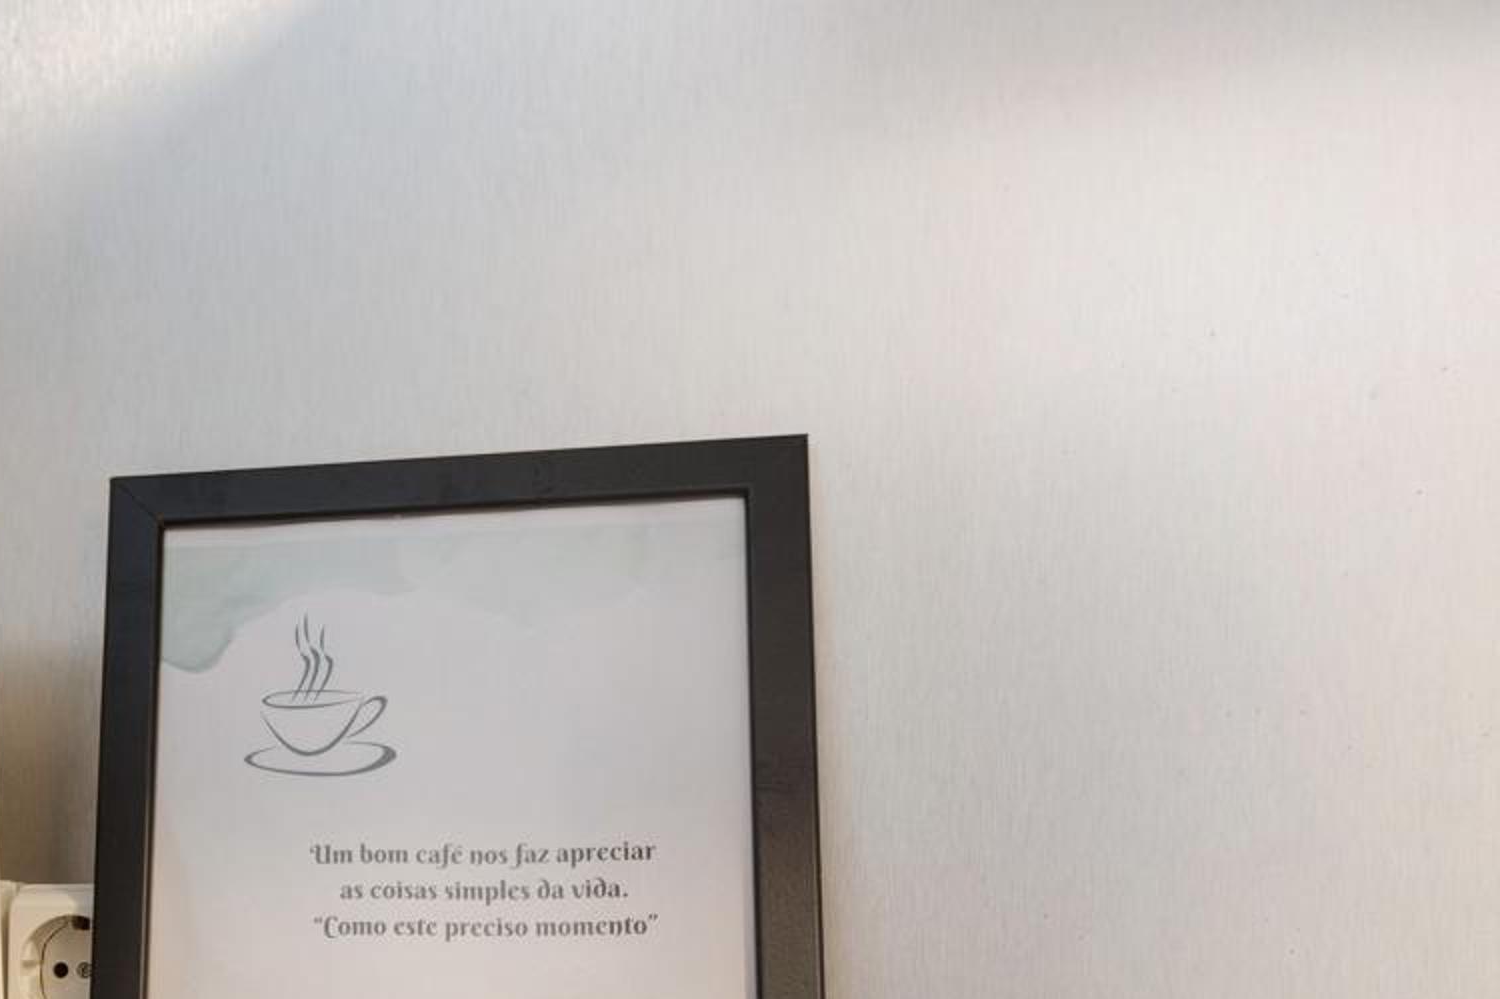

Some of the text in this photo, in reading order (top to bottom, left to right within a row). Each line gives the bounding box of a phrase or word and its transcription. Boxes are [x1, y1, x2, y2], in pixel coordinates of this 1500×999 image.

[360, 843, 408, 864] bom
[416, 843, 464, 869] café
[470, 848, 508, 864] nos
[510, 843, 550, 869] faz
[556, 841, 657, 869] apreciar
[340, 877, 628, 905] as coisas simples da vida.
[394, 918, 437, 936] este
[445, 918, 528, 942] preciso
